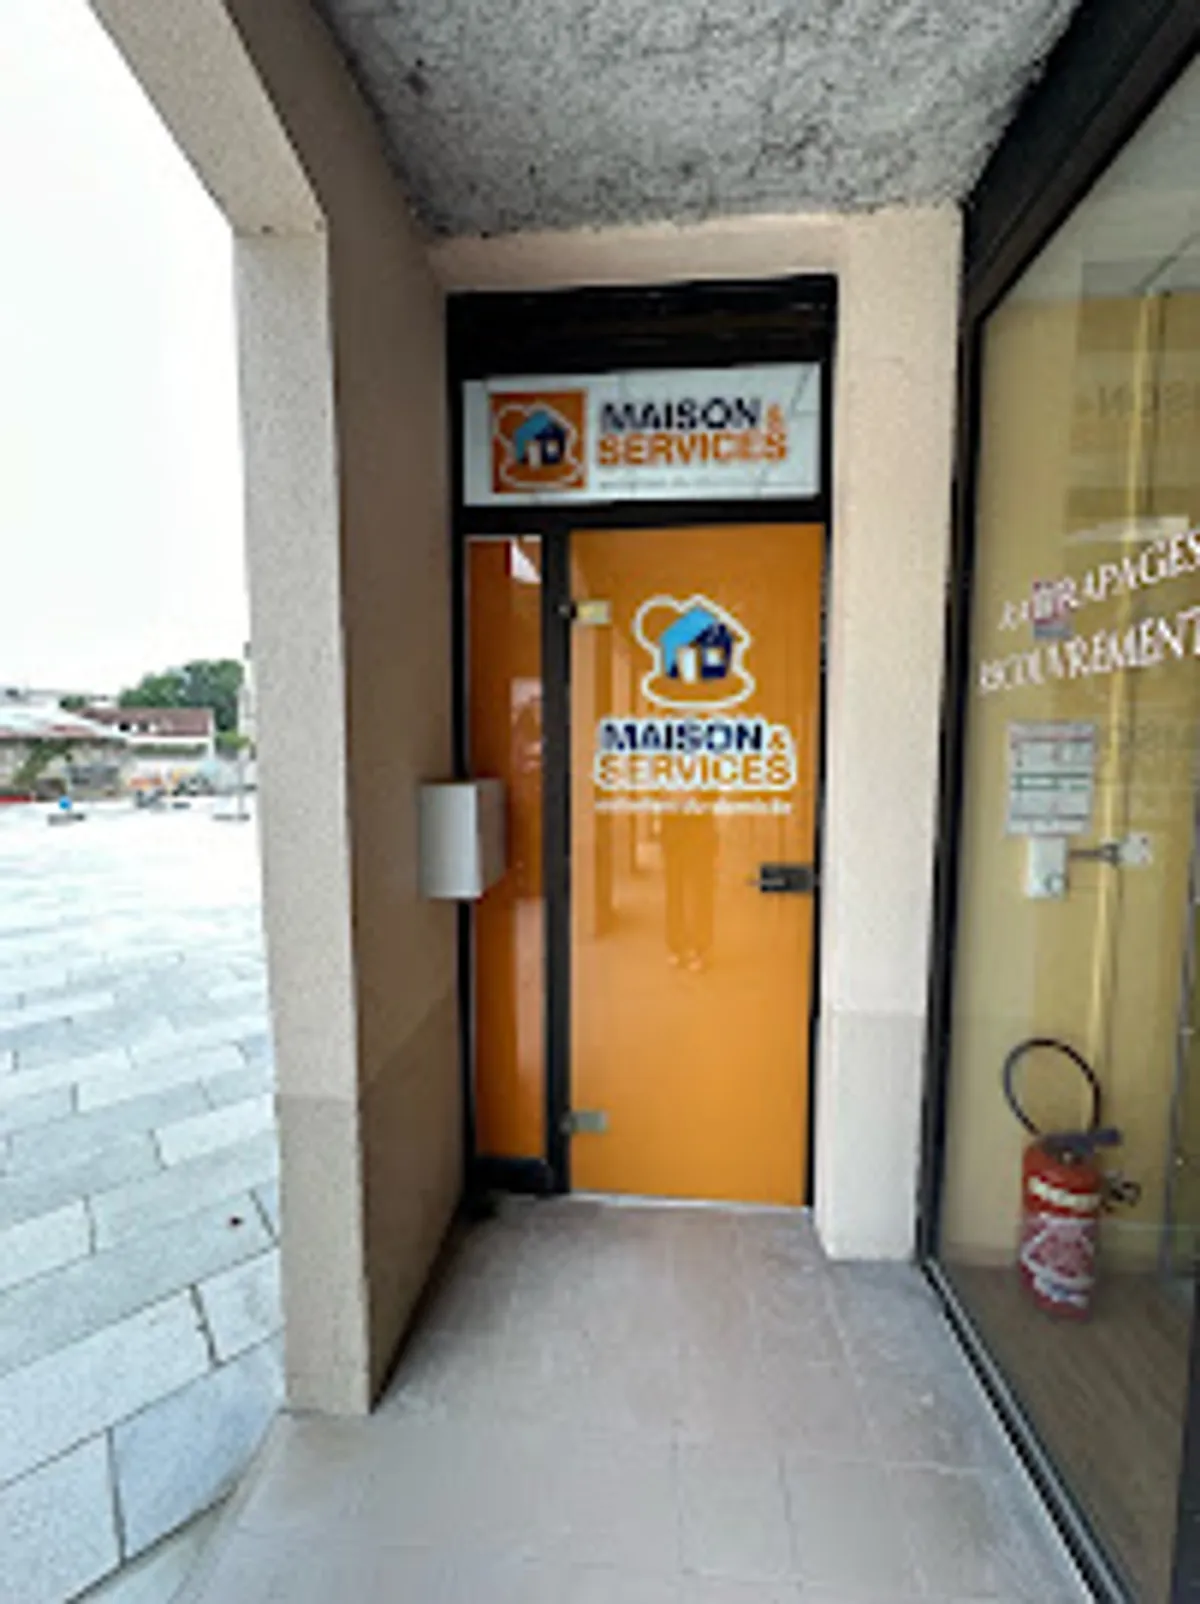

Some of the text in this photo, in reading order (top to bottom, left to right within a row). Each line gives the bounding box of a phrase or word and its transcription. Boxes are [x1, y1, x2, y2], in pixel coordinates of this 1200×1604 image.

[600, 398, 760, 432] MAISON
[598, 430, 788, 467] SERVICES
[602, 721, 763, 752] MAISON
[600, 755, 791, 783] SERVICES
